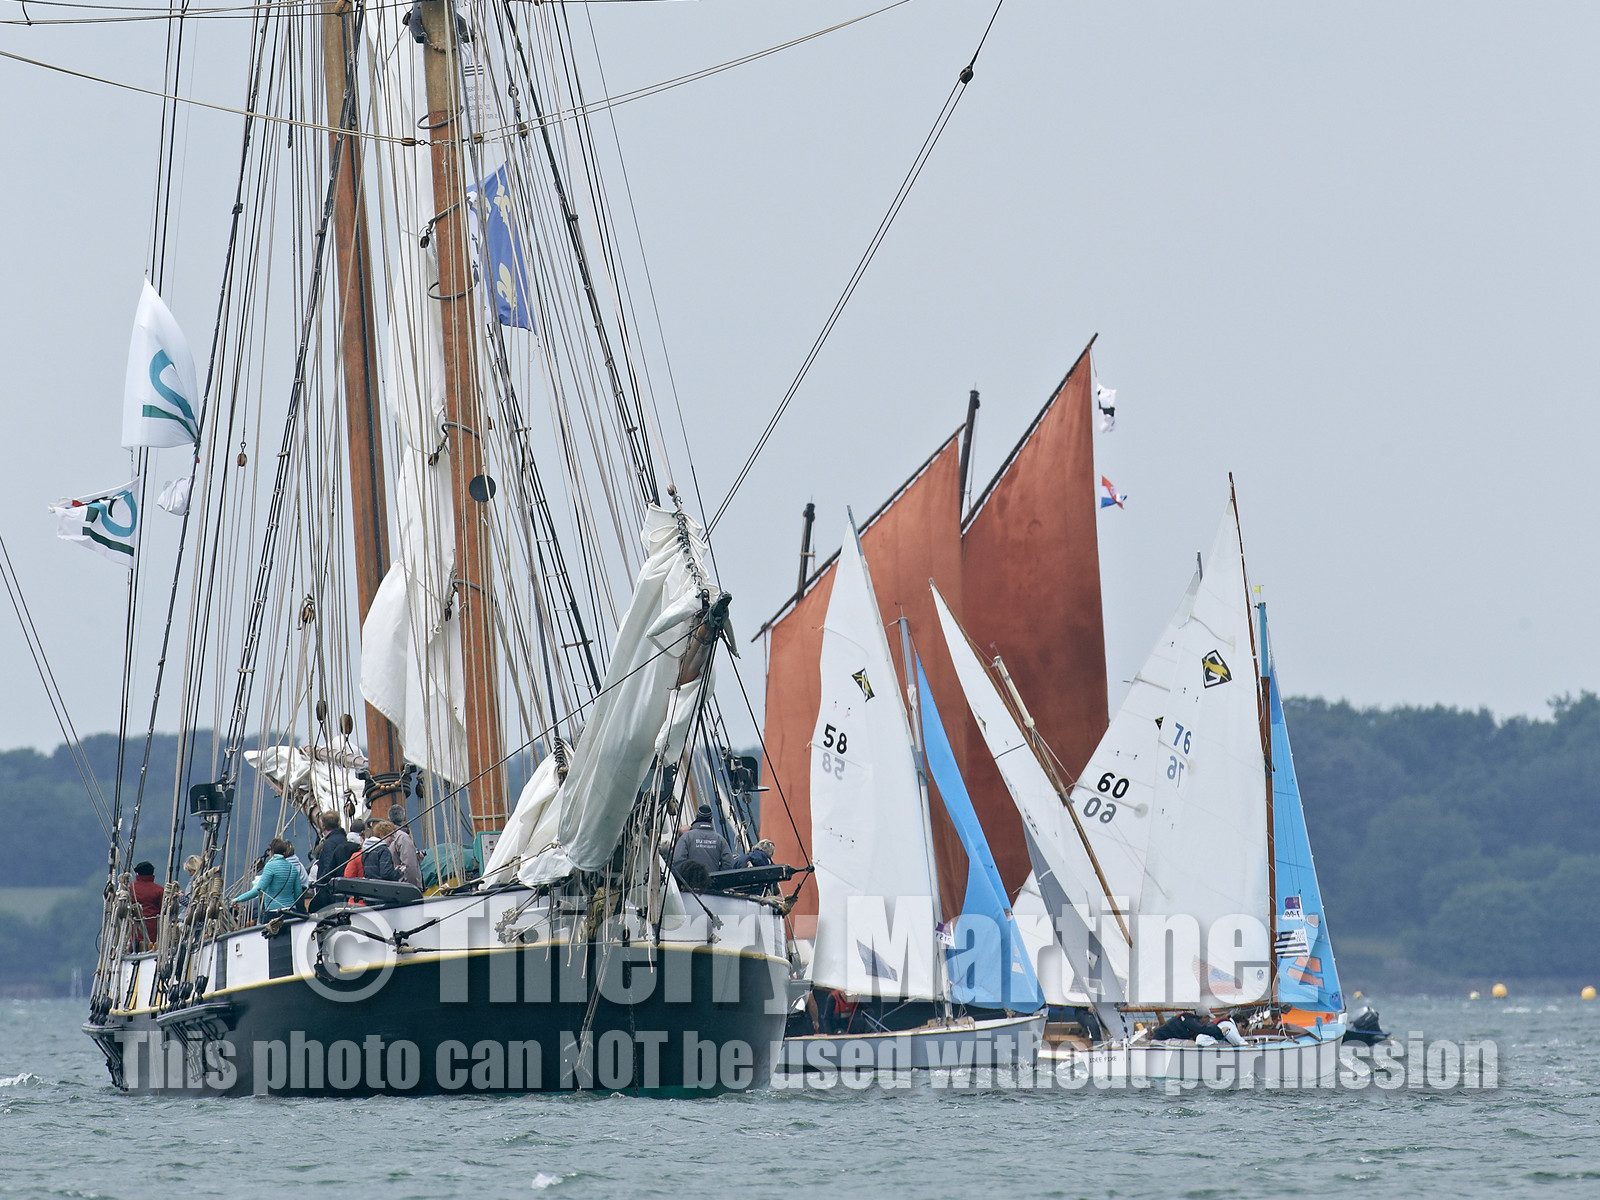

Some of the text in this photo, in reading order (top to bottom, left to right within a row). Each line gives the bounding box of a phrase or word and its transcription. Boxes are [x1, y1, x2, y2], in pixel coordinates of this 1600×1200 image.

[823, 723, 848, 755] 58
[1173, 722, 1192, 755] 76
[1096, 772, 1130, 799] 60
